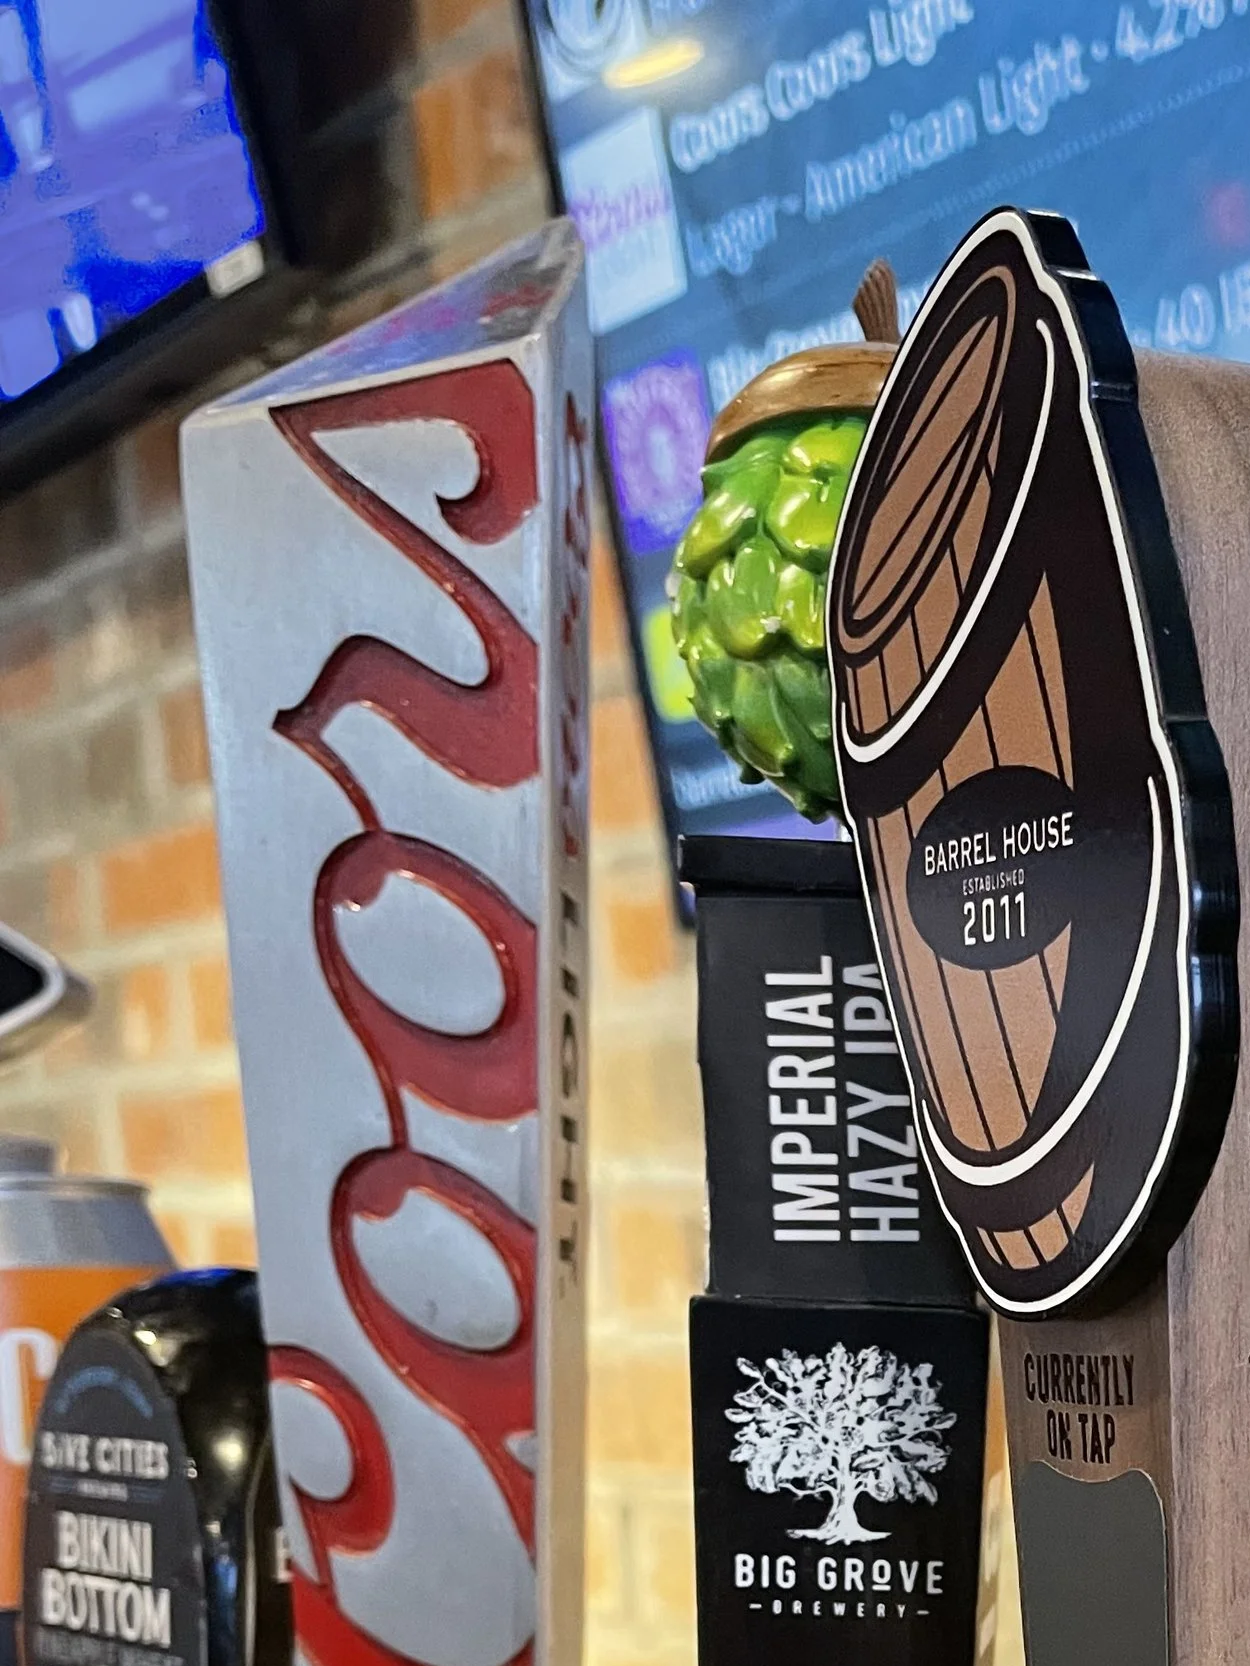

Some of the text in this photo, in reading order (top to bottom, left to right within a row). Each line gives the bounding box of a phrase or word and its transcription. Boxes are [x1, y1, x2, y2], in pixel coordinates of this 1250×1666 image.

[804, 96, 979, 222] American
[978, 33, 1090, 136] Light
[924, 811, 1075, 877] BARREL HOUSE
[962, 868, 1026, 897] ESTABLISHED
[963, 891, 1026, 946] 2011
[764, 954, 842, 1243] IMPERIAL
[842, 962, 921, 1243] HAZY IPA
[1023, 1352, 1134, 1407] CURRENTLY
[1046, 1408, 1116, 1465] ON TAP
[56, 1509, 153, 1583] BIKINI
[734, 1553, 944, 1595] BIG GROVE
[42, 1566, 172, 1650] BOTTOM
